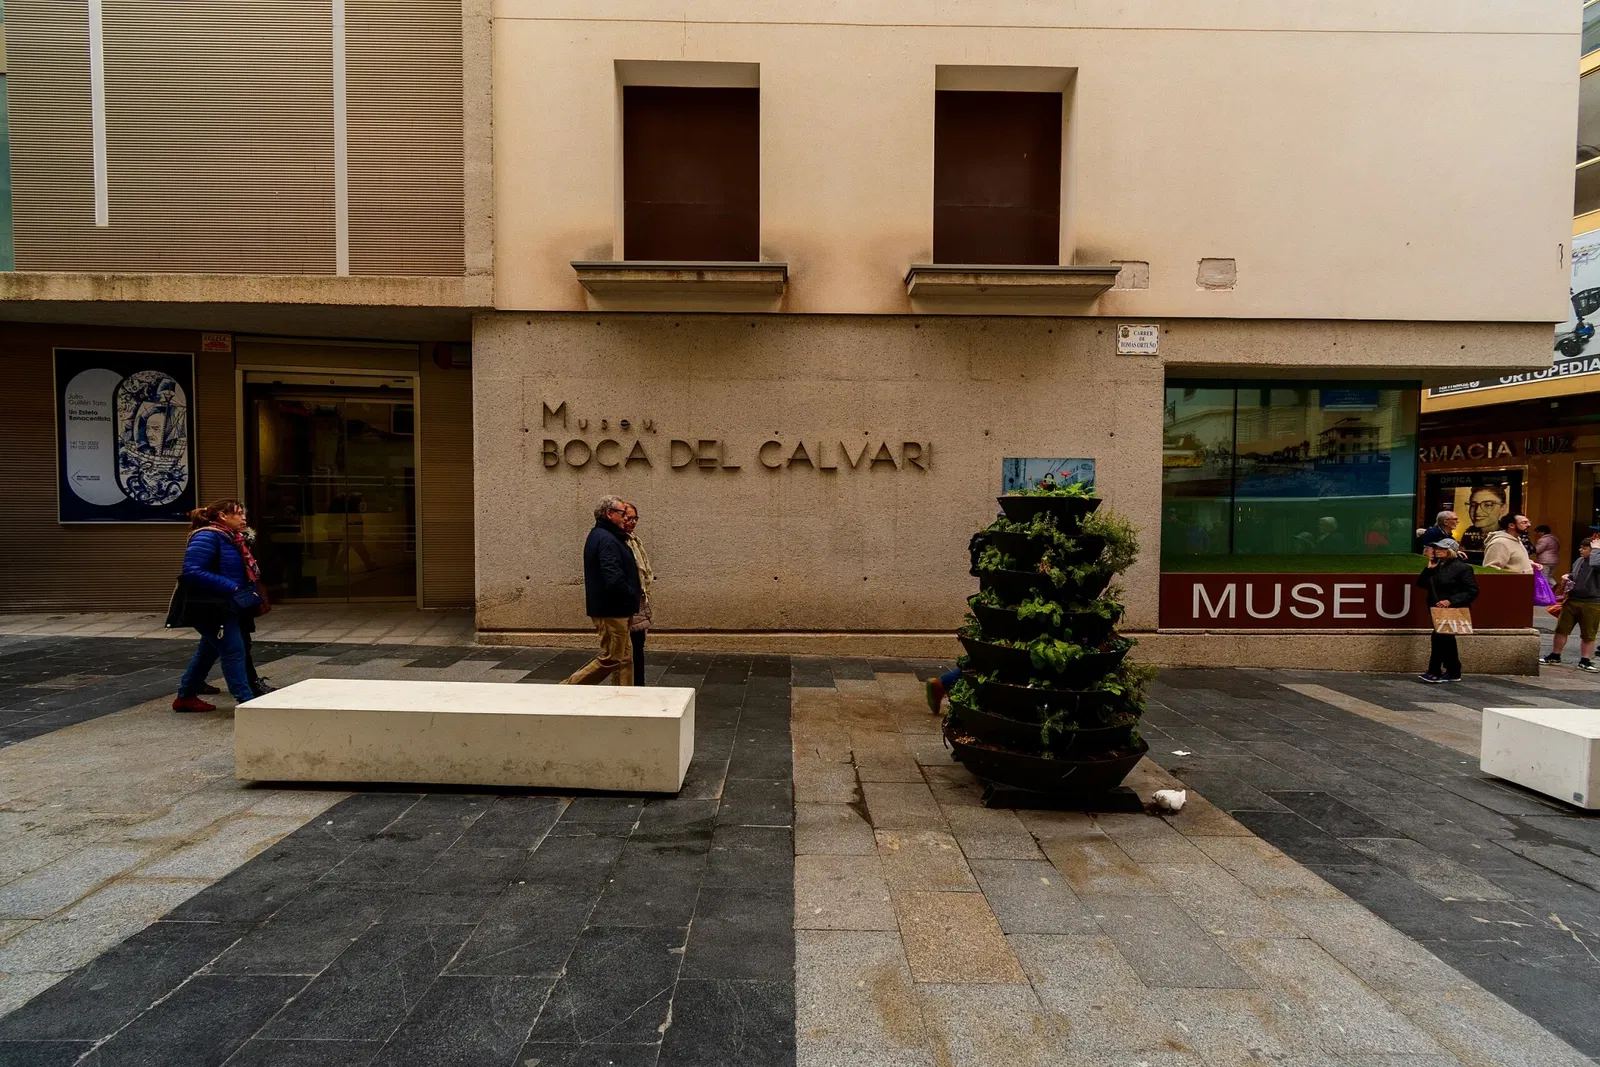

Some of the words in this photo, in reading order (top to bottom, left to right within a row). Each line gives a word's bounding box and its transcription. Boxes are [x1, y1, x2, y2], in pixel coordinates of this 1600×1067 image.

[541, 439, 654, 469] BOCA
[670, 439, 742, 470] DEL
[759, 440, 932, 471] CALVARI
[1524, 436, 1569, 455] LUZ
[1191, 583, 1411, 619] MUSEU
